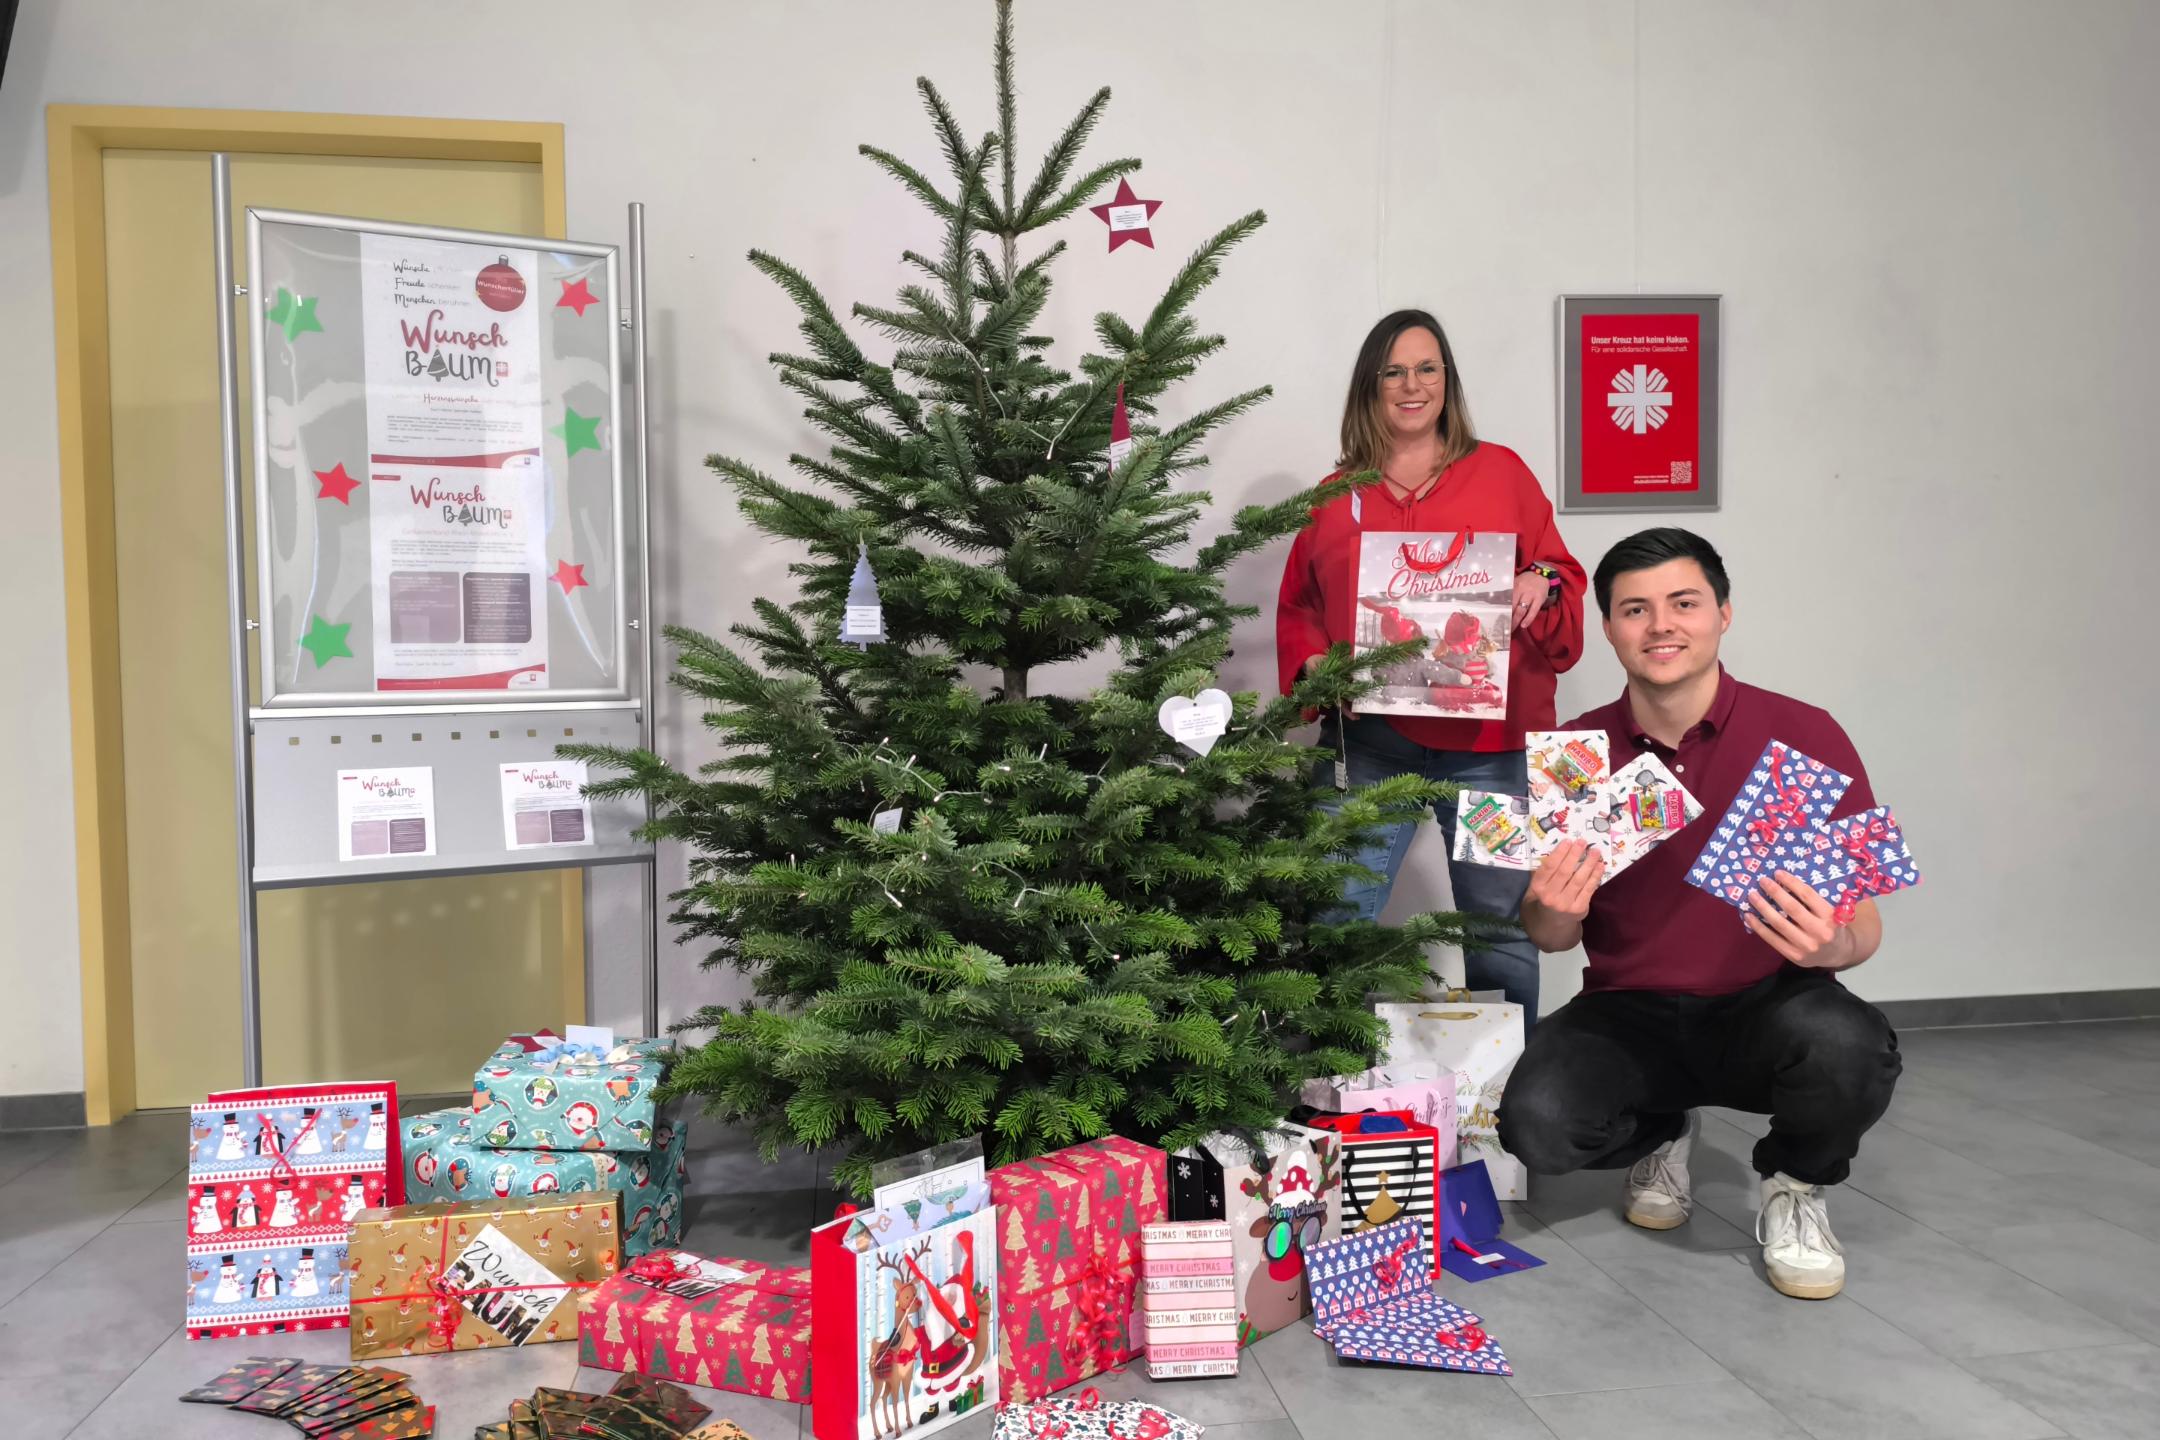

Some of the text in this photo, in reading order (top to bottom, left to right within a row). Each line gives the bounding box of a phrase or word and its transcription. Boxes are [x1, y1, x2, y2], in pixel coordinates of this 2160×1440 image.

[395, 277, 425, 290] Freude
[394, 293, 435, 308] Menschen
[401, 309, 508, 353] Wunsch
[1591, 336, 1611, 344] Unser
[1612, 336, 1632, 344] Kreuz
[1633, 336, 1645, 344] hat
[1646, 336, 1665, 344] keine
[410, 477, 486, 509] Wunsch
[1387, 569, 1492, 600] Christmas
[1569, 744, 1598, 770] HARIBO
[362, 776, 402, 791] Wunsch
[523, 769, 560, 783] Wunsch
[1468, 803, 1494, 825] HARIBO
[1669, 793, 1679, 825] HARIBO
[1150, 1264, 1174, 1273] MERRY
[1169, 1280, 1193, 1289] MERRY
[1153, 1348, 1178, 1358] MERRY
[1172, 1364, 1198, 1375] MERRY
